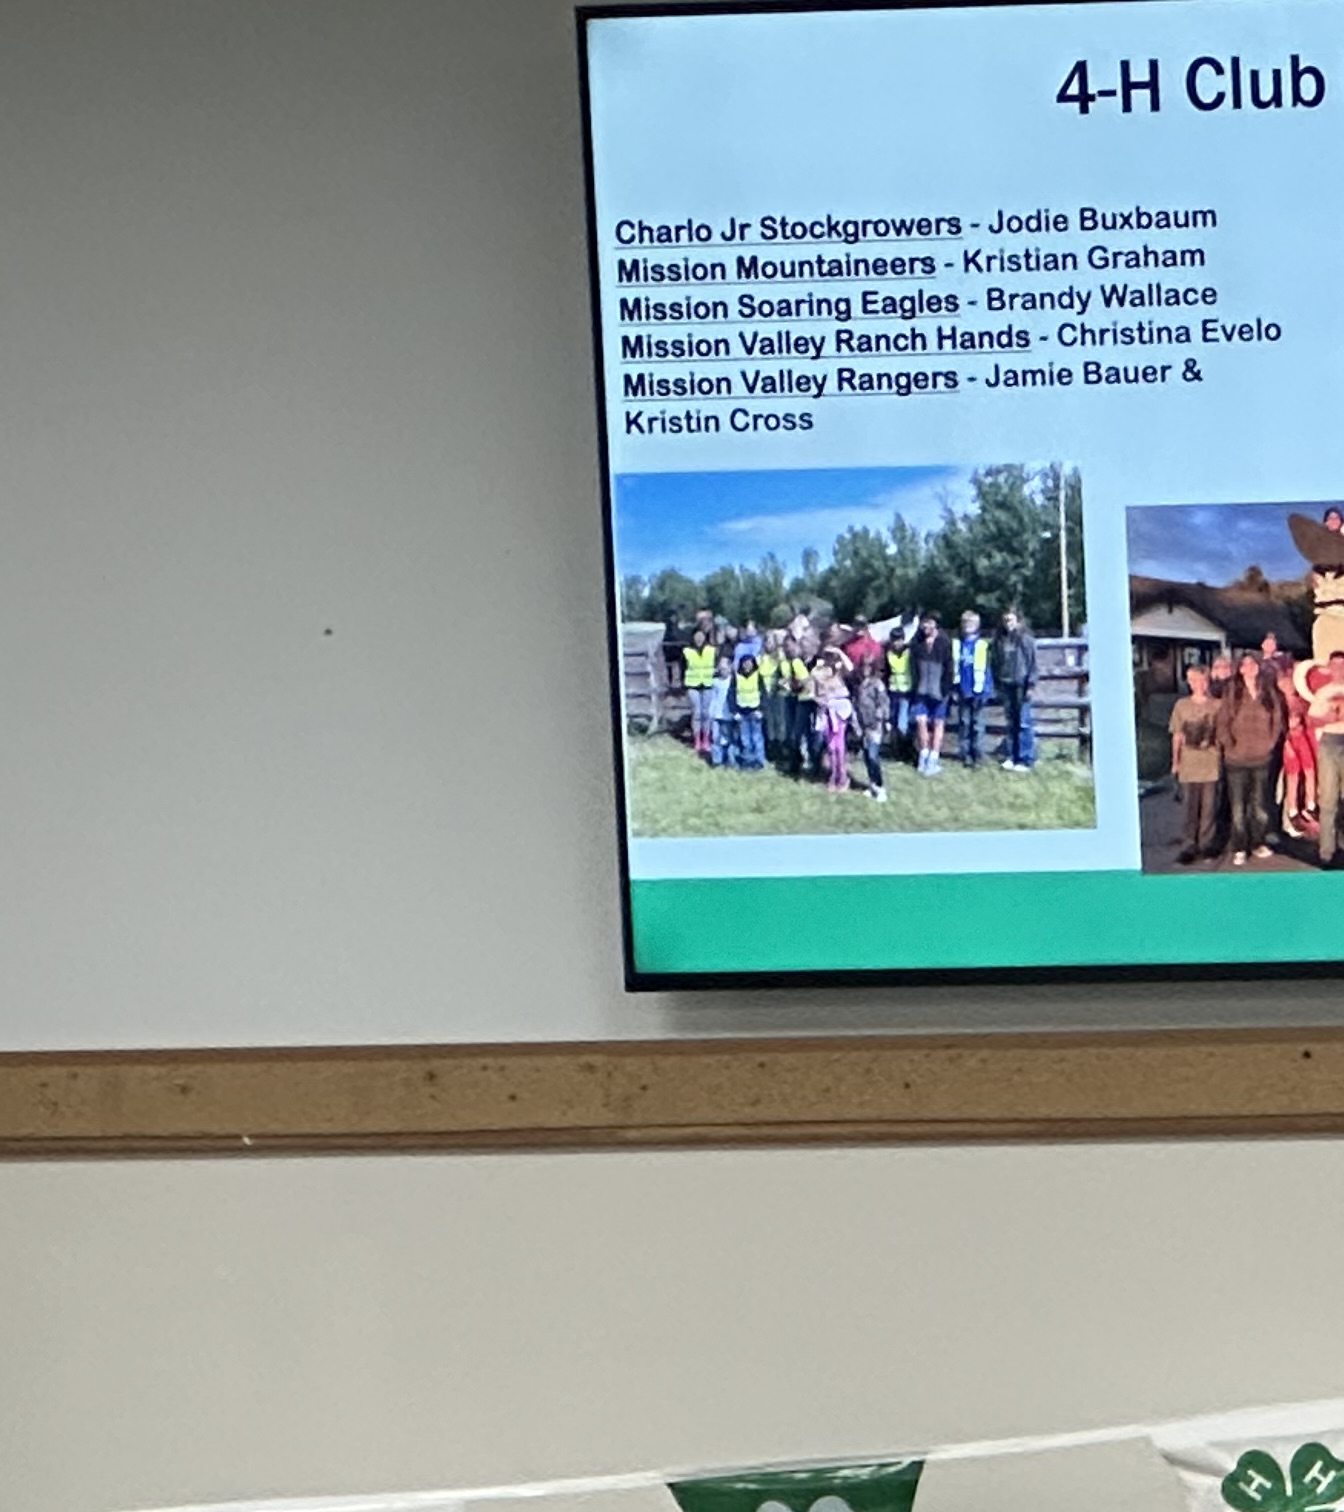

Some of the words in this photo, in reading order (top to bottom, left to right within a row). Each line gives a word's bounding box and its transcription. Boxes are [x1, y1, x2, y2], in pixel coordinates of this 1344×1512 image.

[1055, 58, 1161, 115] 4-H
[1185, 53, 1326, 112] Club
[615, 218, 713, 248] Charlo
[720, 217, 752, 242] Jr
[759, 213, 962, 245] Stockgrowers
[988, 208, 1069, 235] Jodie
[1079, 205, 1217, 232] Buxbaum
[617, 257, 727, 283] Mission
[736, 252, 936, 280] Mountaineers
[963, 247, 1078, 274] Kristian
[1087, 244, 1206, 270] Graham
[619, 295, 729, 322] Mission
[738, 292, 853, 323] Soaring
[861, 288, 960, 321] Eagles
[986, 285, 1092, 316] Brandy
[1100, 282, 1218, 309] Wallace
[621, 332, 731, 359] Mission
[738, 330, 826, 361] Valley
[835, 326, 927, 354] Ranch
[936, 323, 1031, 351] Hands
[1057, 320, 1192, 347] Christina
[1201, 317, 1282, 343] Evelo
[623, 371, 732, 398] Mission
[740, 368, 828, 400] Valley
[837, 367, 959, 397] Rangers
[985, 361, 1073, 388] Jamie
[1083, 361, 1173, 385] Bauer
[1181, 357, 1204, 383] &
[625, 409, 720, 435] Kristin
[729, 407, 814, 433] Cross
